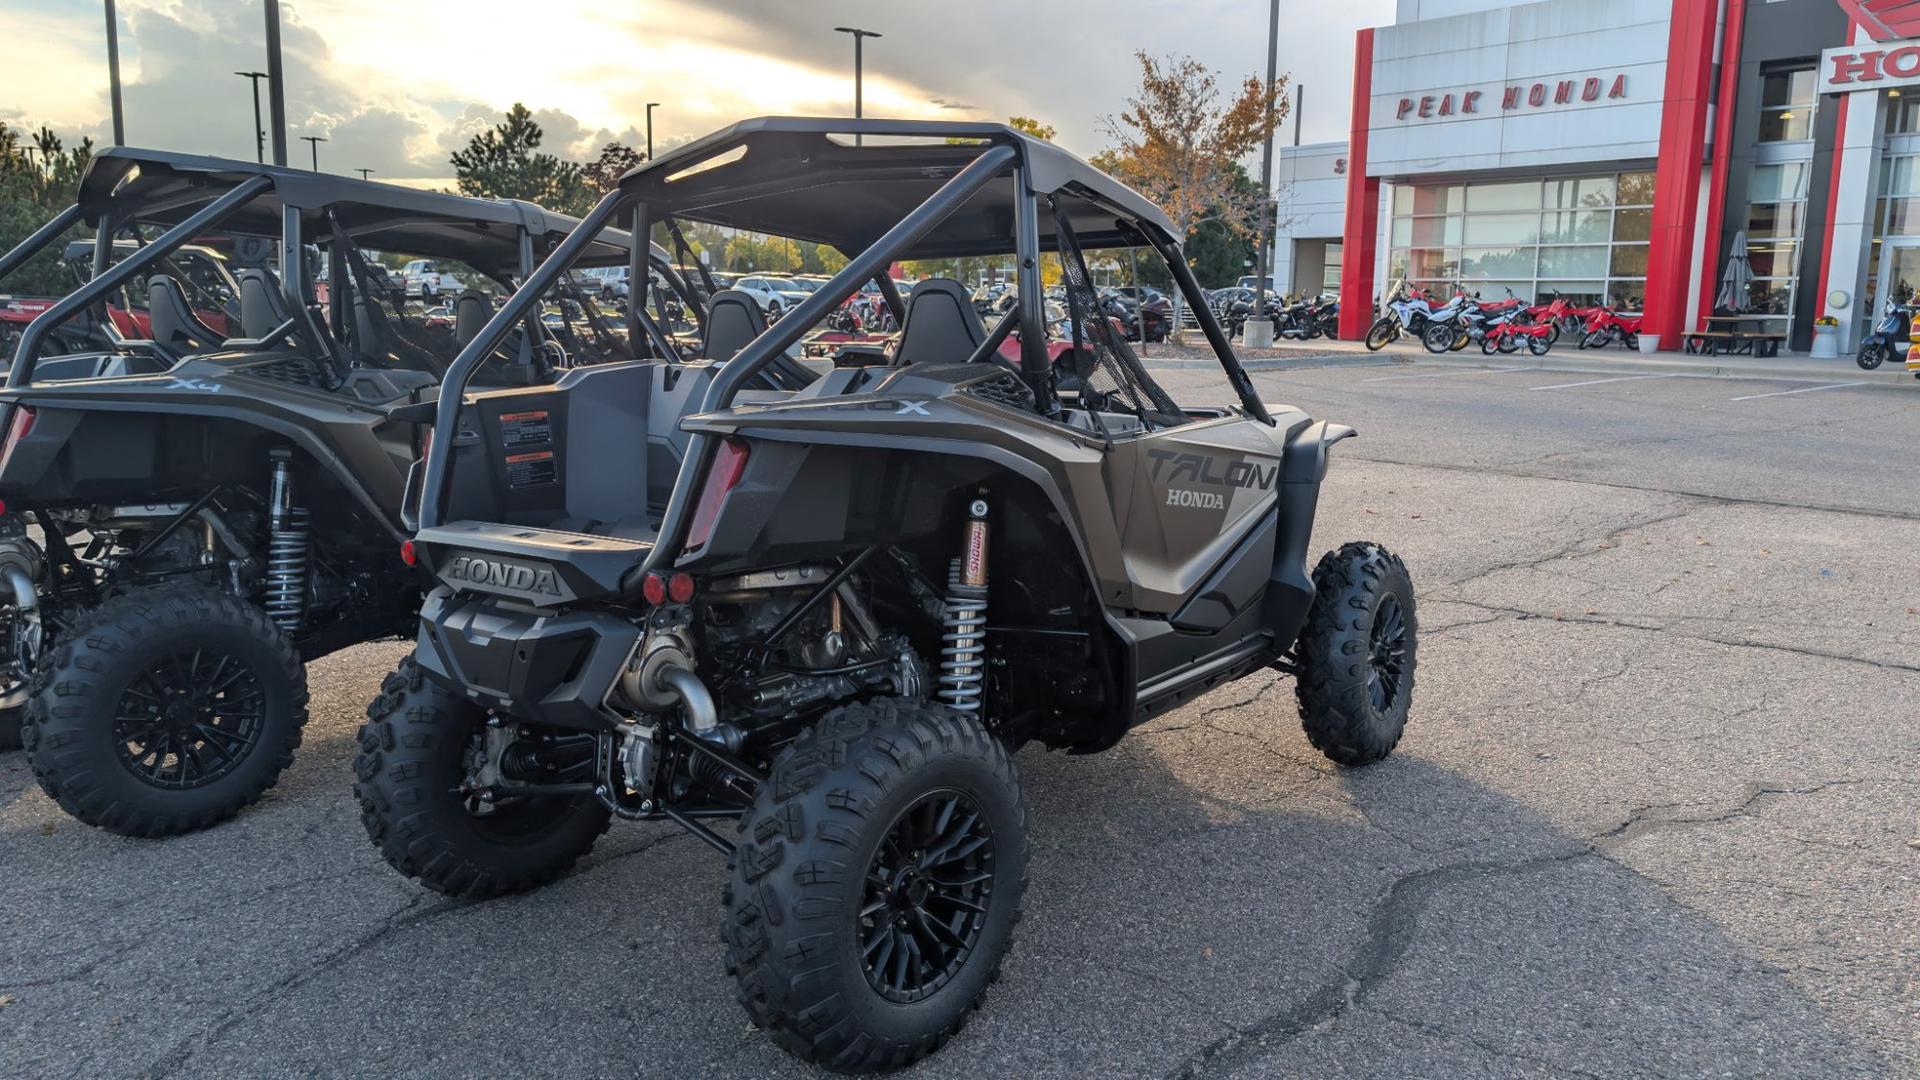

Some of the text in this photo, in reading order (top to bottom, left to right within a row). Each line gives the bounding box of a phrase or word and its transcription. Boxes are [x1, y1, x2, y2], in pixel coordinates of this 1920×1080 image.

[1396, 74, 1625, 120] PEAK HONDA
[1147, 449, 1277, 490] TALON
[1166, 489, 1225, 509] HONDA
[968, 527, 982, 572] SHOWA
[447, 557, 562, 597] HONDA
